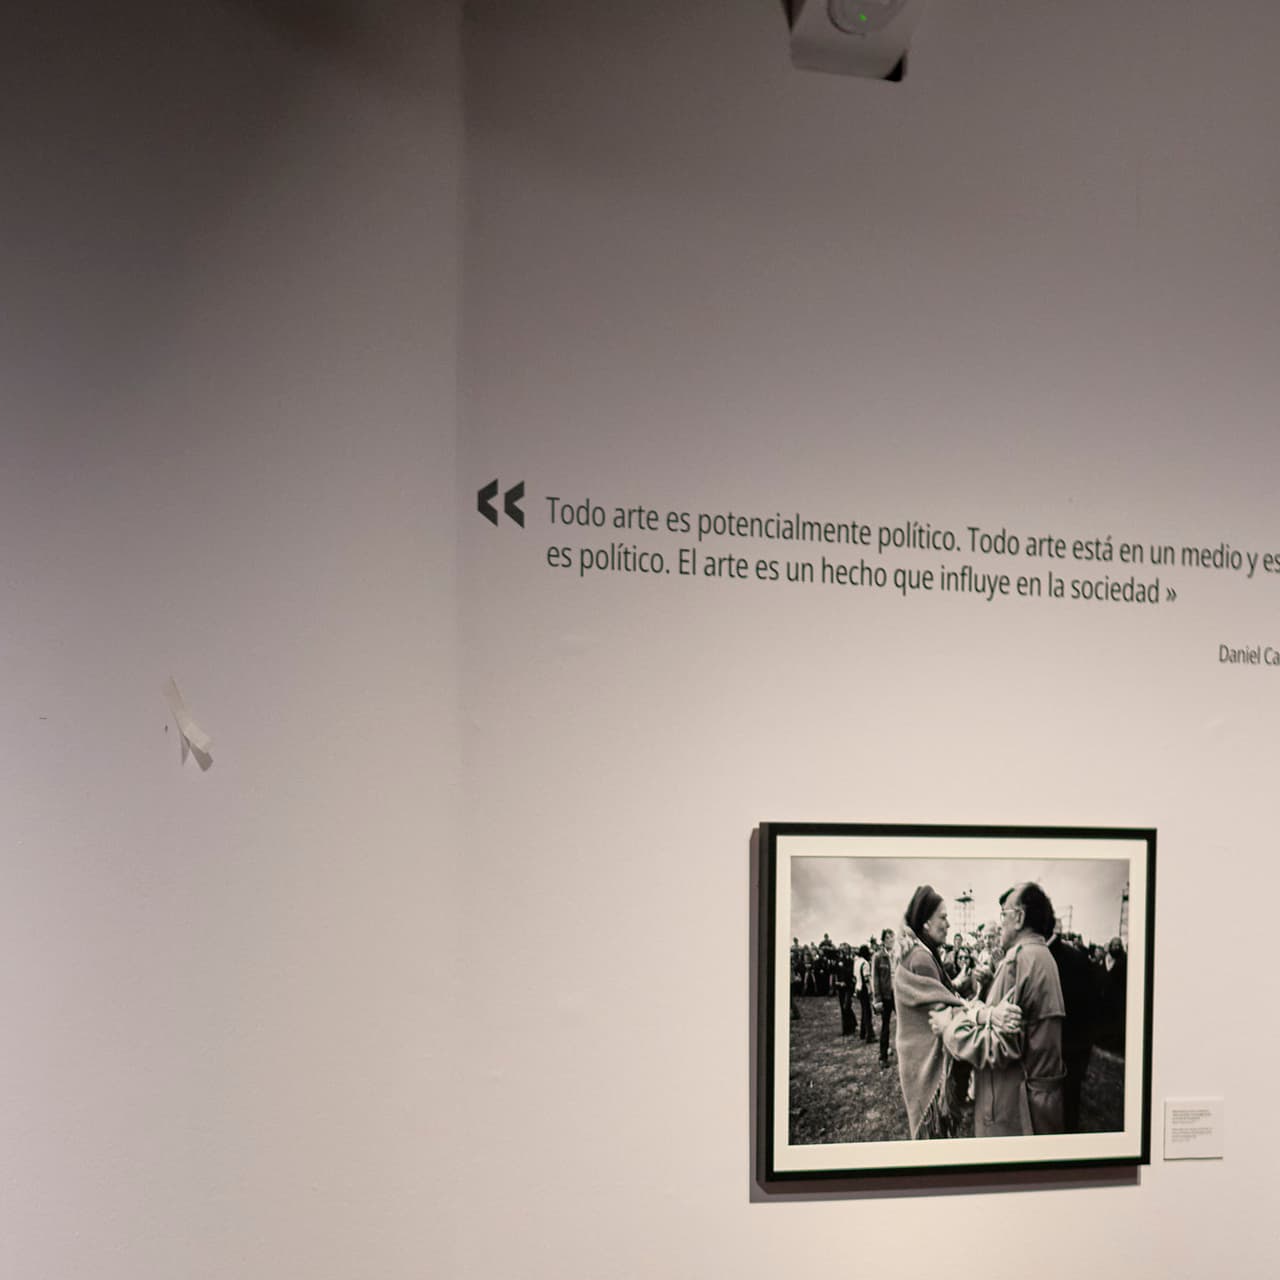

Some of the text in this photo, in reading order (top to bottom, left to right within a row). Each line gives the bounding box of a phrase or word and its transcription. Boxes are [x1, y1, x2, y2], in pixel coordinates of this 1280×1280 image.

[546, 497, 605, 527] Todo
[613, 506, 659, 530] arte
[667, 512, 690, 532] es
[699, 512, 871, 545] potencialmente
[879, 522, 960, 554] político.
[968, 527, 1019, 555] Todo
[1026, 536, 1066, 558] arte
[1073, 536, 1113, 561] está
[1120, 544, 1143, 563] en
[1151, 546, 1175, 565] un
[1182, 543, 1242, 570] medio
[1247, 552, 1258, 578] y
[547, 546, 572, 568] es
[581, 543, 670, 577] político.
[679, 548, 696, 575] El
[704, 554, 748, 578] arte
[756, 560, 779, 580] es
[787, 562, 813, 582] un
[822, 557, 887, 587] hecho
[894, 569, 933, 596] que
[941, 565, 1010, 601] influye
[1017, 577, 1041, 596] en
[1049, 571, 1064, 598] la
[1071, 576, 1159, 604] sociedad
[1219, 644, 1260, 664] Daniel
